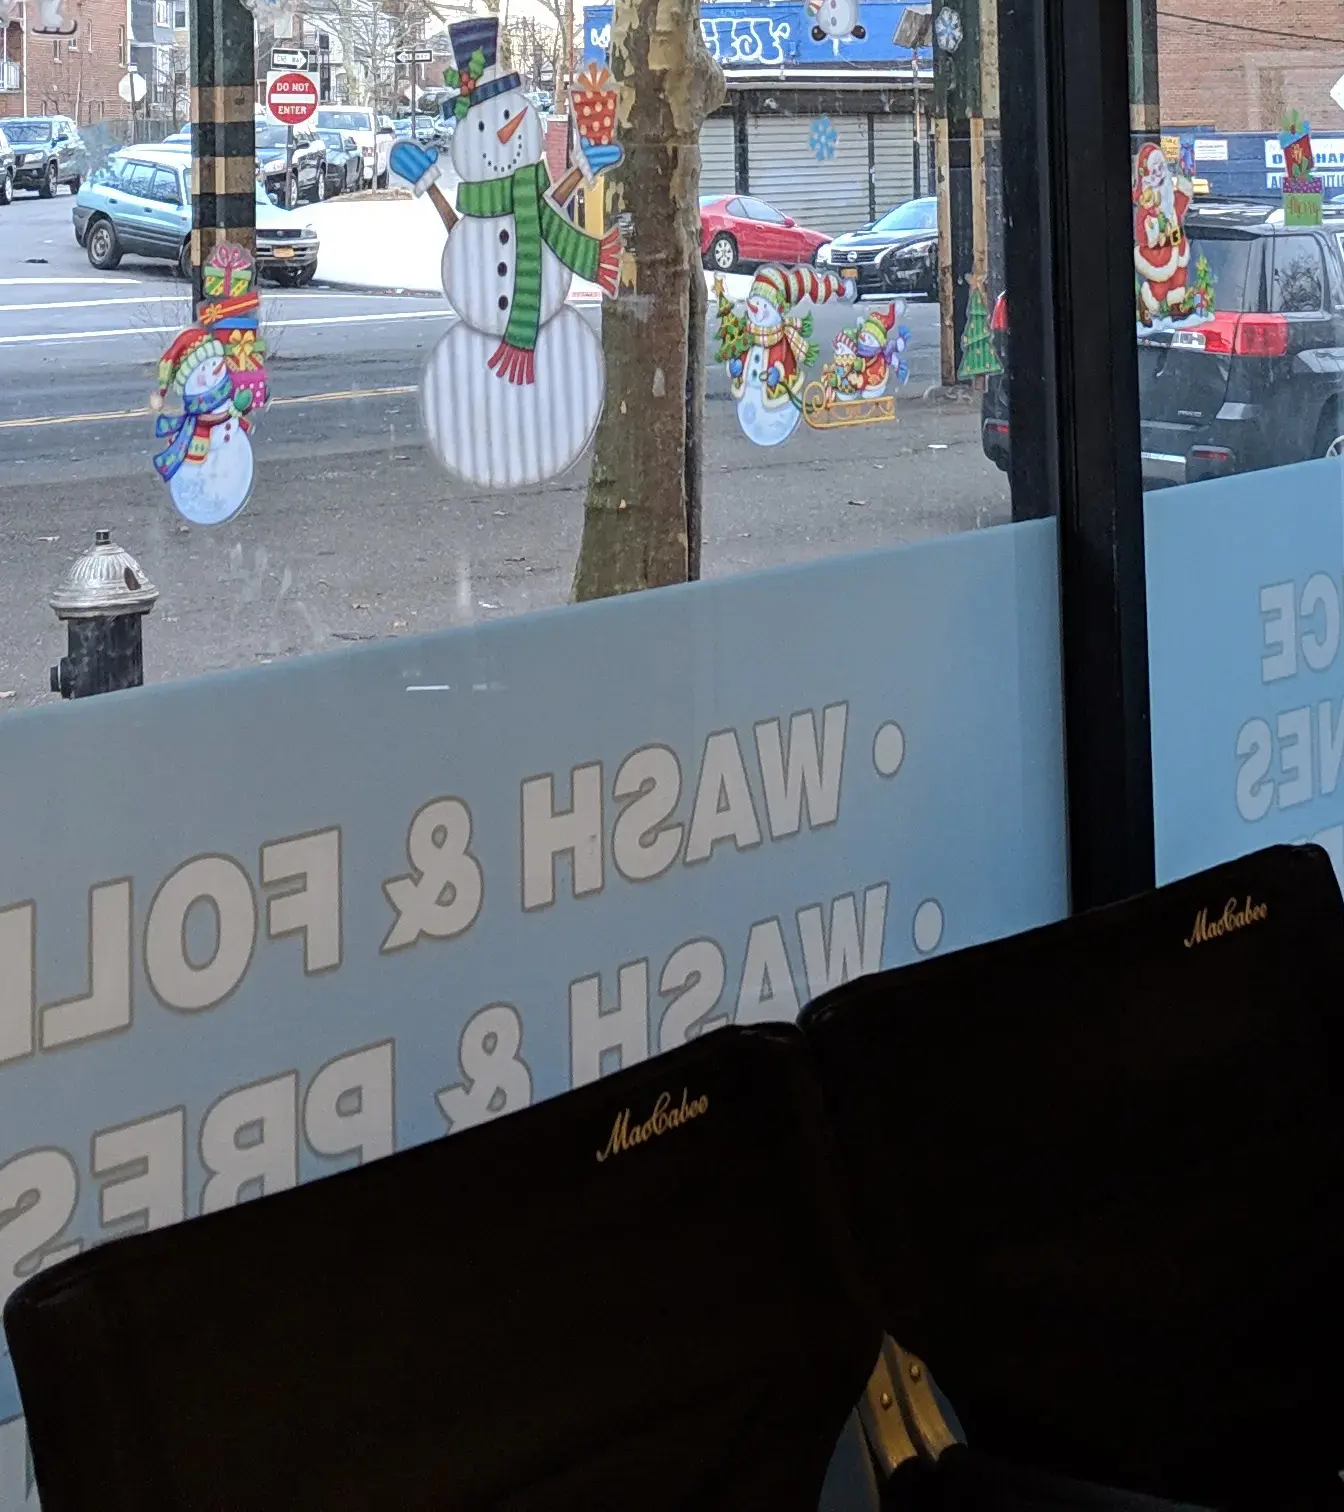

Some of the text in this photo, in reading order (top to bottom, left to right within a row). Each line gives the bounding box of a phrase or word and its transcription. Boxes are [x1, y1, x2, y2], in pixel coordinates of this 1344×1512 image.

[276, 82, 309, 92] DO NOT
[278, 106, 306, 116] ENTER
[1184, 894, 1268, 948] MacCabee
[596, 1086, 709, 1163] MacCabee
